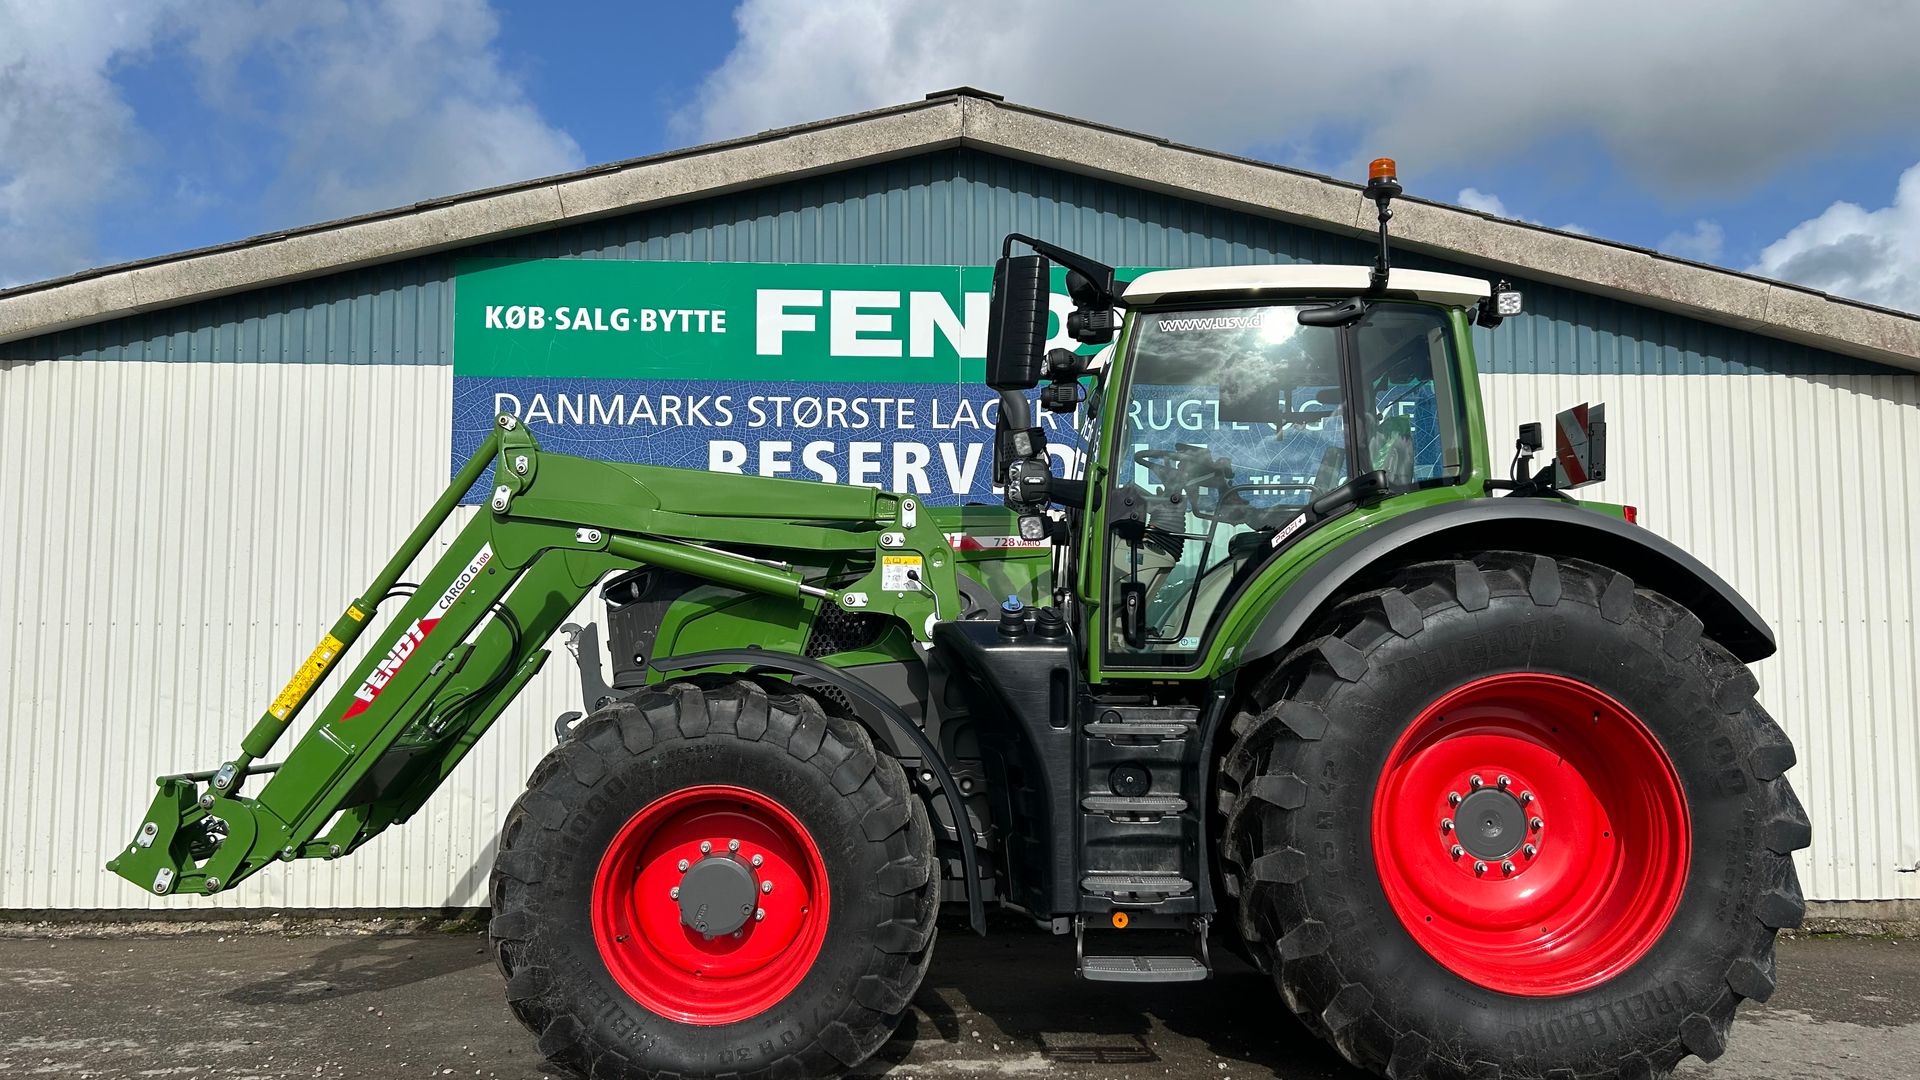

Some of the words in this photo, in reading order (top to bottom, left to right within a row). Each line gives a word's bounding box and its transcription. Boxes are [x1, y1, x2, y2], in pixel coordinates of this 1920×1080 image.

[1158, 312, 1268, 333] www.usv.d
[494, 392, 733, 427] DANMARKS
[747, 396, 915, 431] STØRSTE
[994, 537, 1015, 548] 728
[1016, 540, 1041, 548] VARIO
[354, 618, 425, 703] FENDT
[439, 573, 472, 610] CARGO
[469, 564, 479, 575] 6
[477, 553, 490, 567] 100
